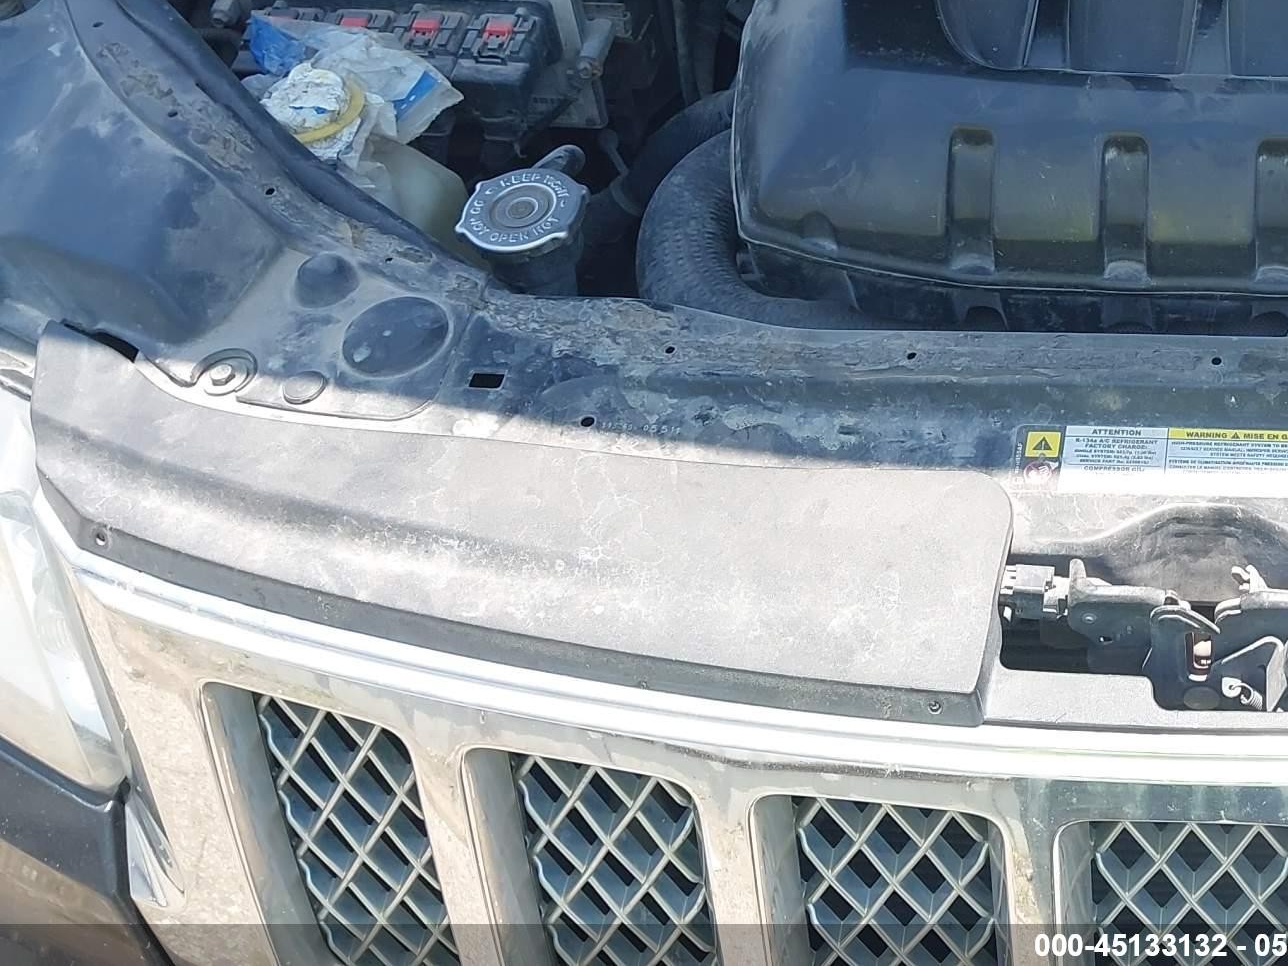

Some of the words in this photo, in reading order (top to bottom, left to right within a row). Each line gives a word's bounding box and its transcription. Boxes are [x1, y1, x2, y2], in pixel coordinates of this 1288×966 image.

[489, 231, 530, 243] OPEN
[1091, 428, 1142, 437] ATTENTION
[1186, 431, 1228, 439] WARNING
